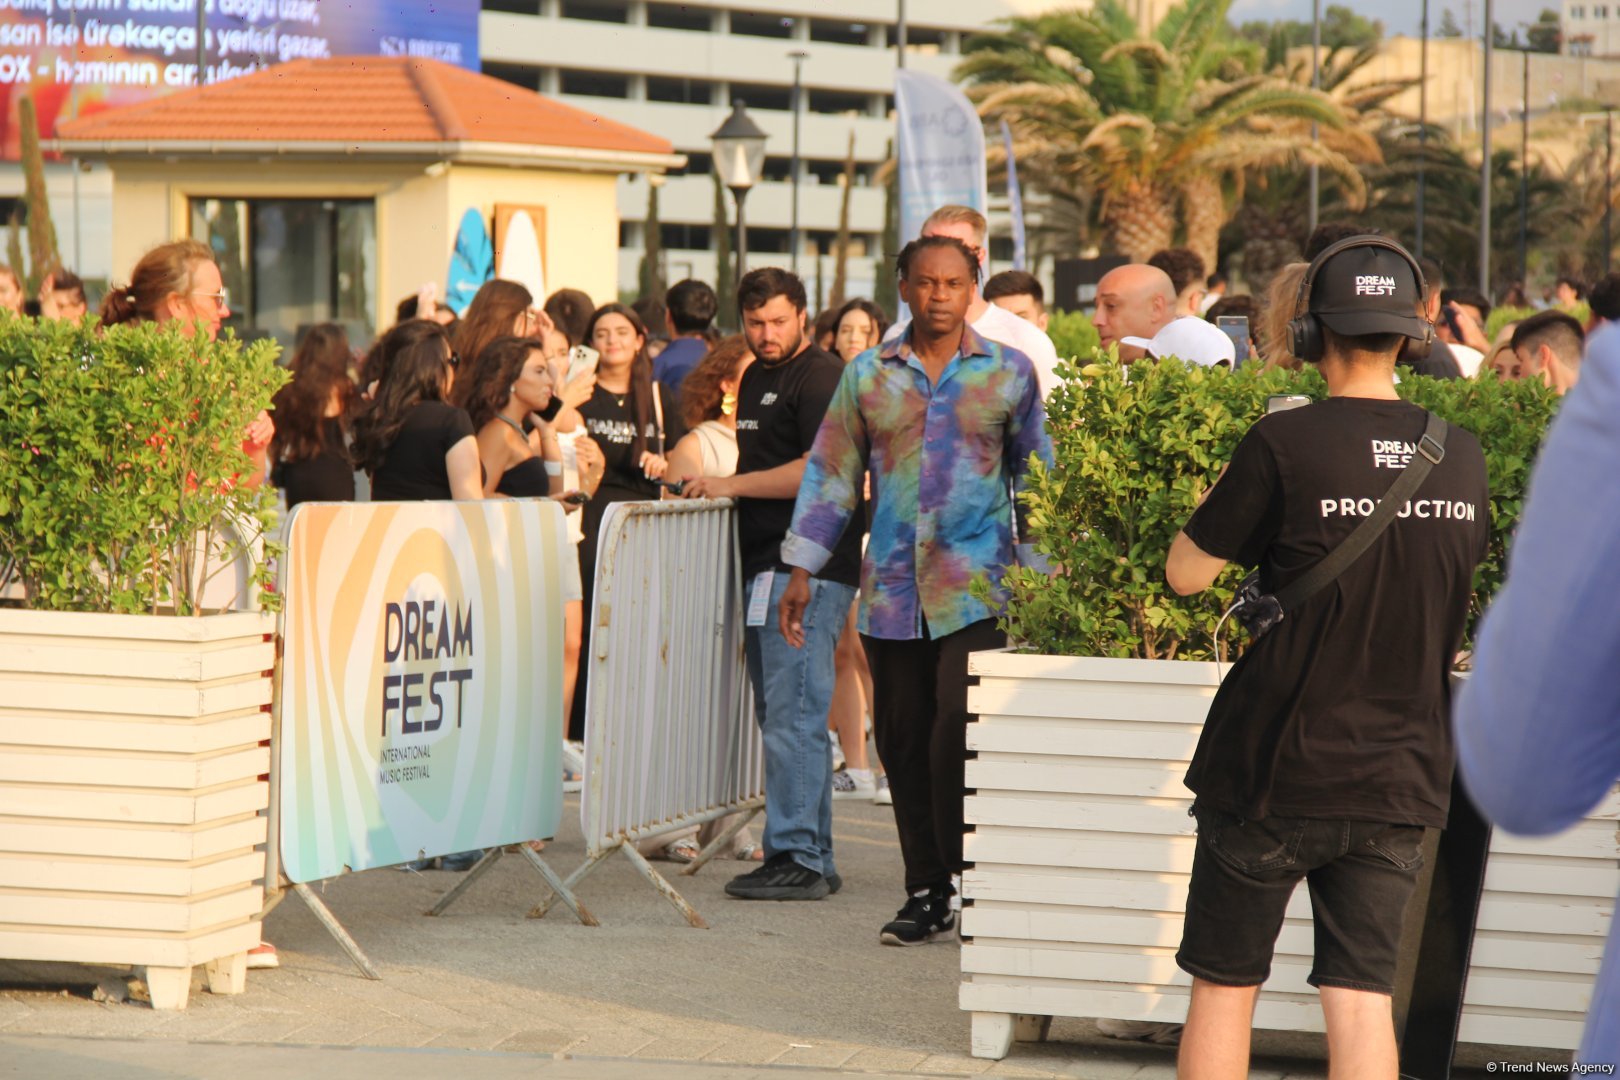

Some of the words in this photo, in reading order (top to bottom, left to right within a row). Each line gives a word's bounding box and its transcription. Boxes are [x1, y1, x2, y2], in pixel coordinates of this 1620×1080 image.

[1355, 275, 1396, 286] DREAM
[1356, 285, 1397, 296] FEST
[1373, 454, 1413, 469] FES
[1320, 498, 1476, 522] PROUCTION
[383, 598, 474, 664] DREAM
[381, 668, 474, 738] FEST
[380, 744, 431, 764] INTERNATIONAL
[379, 768, 402, 785] MUSIC
[402, 764, 430, 782] FESTIVAL
